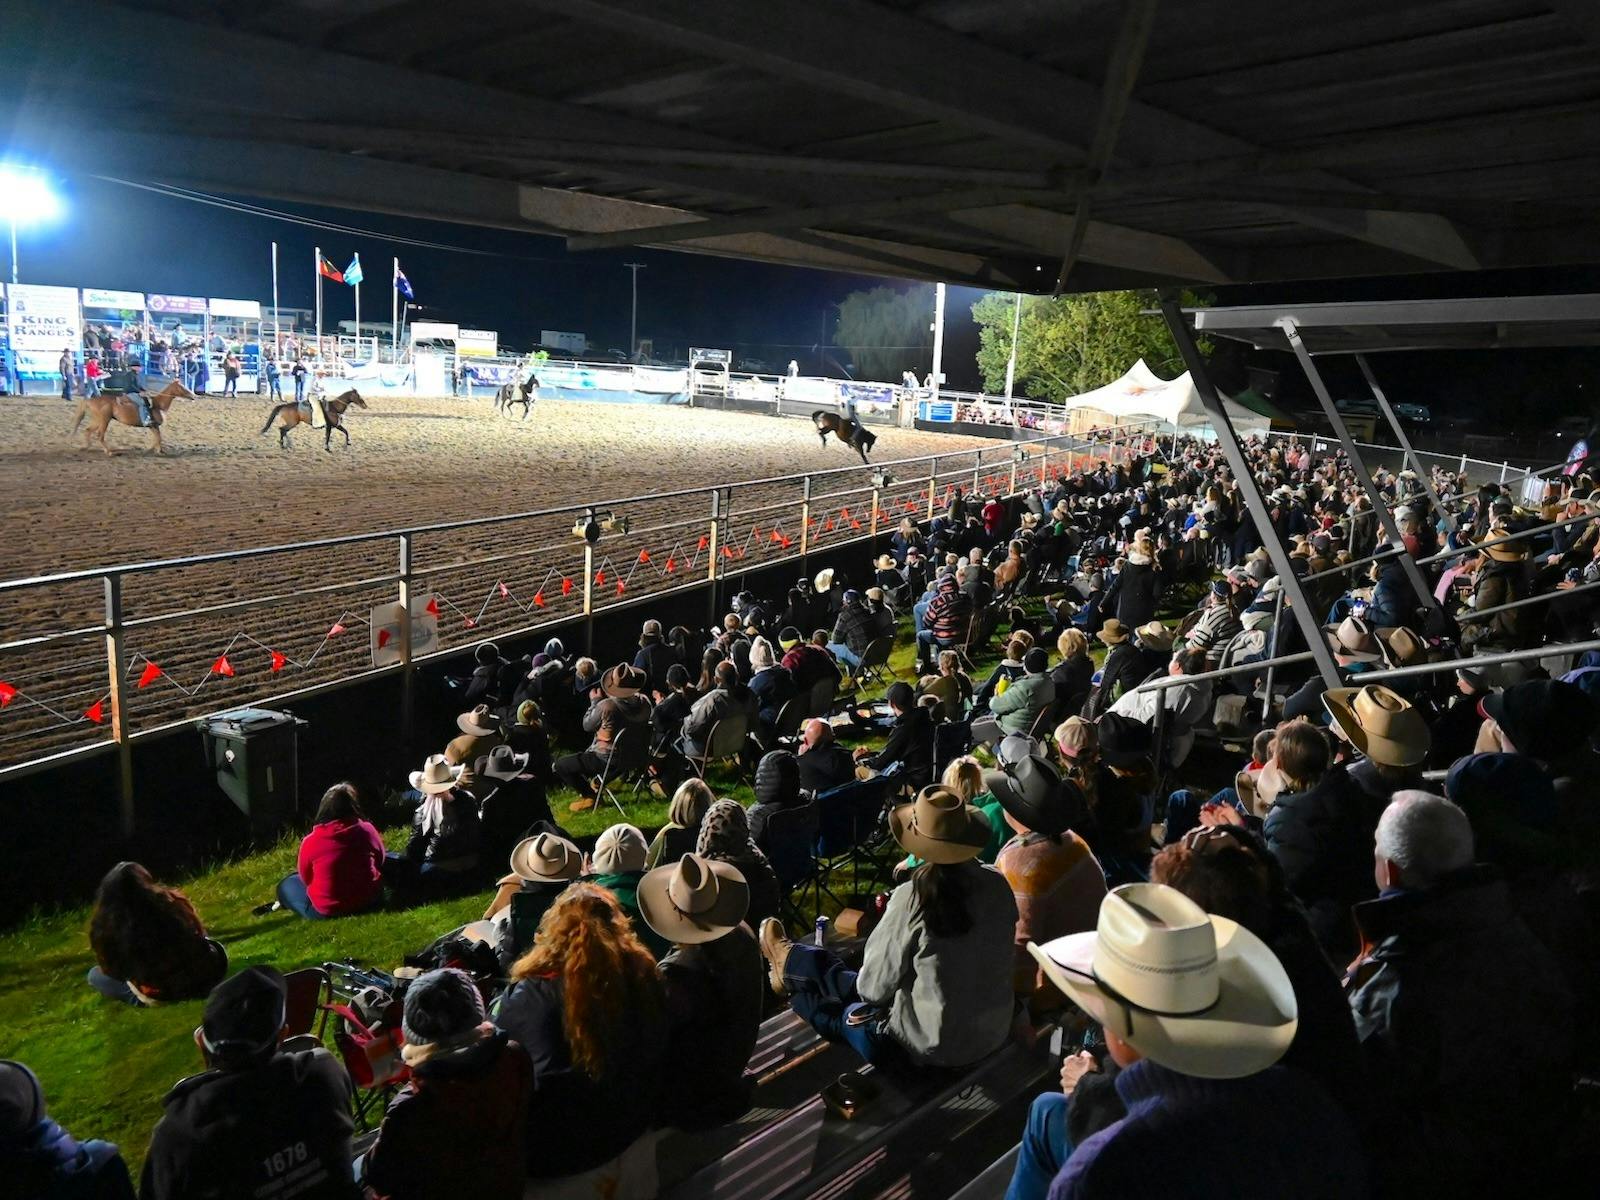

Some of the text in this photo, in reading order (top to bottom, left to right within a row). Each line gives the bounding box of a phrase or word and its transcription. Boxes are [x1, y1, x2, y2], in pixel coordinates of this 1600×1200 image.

[21, 315, 67, 325] KING
[14, 325, 75, 336] RANGES
[263, 1141, 307, 1177] 1678
